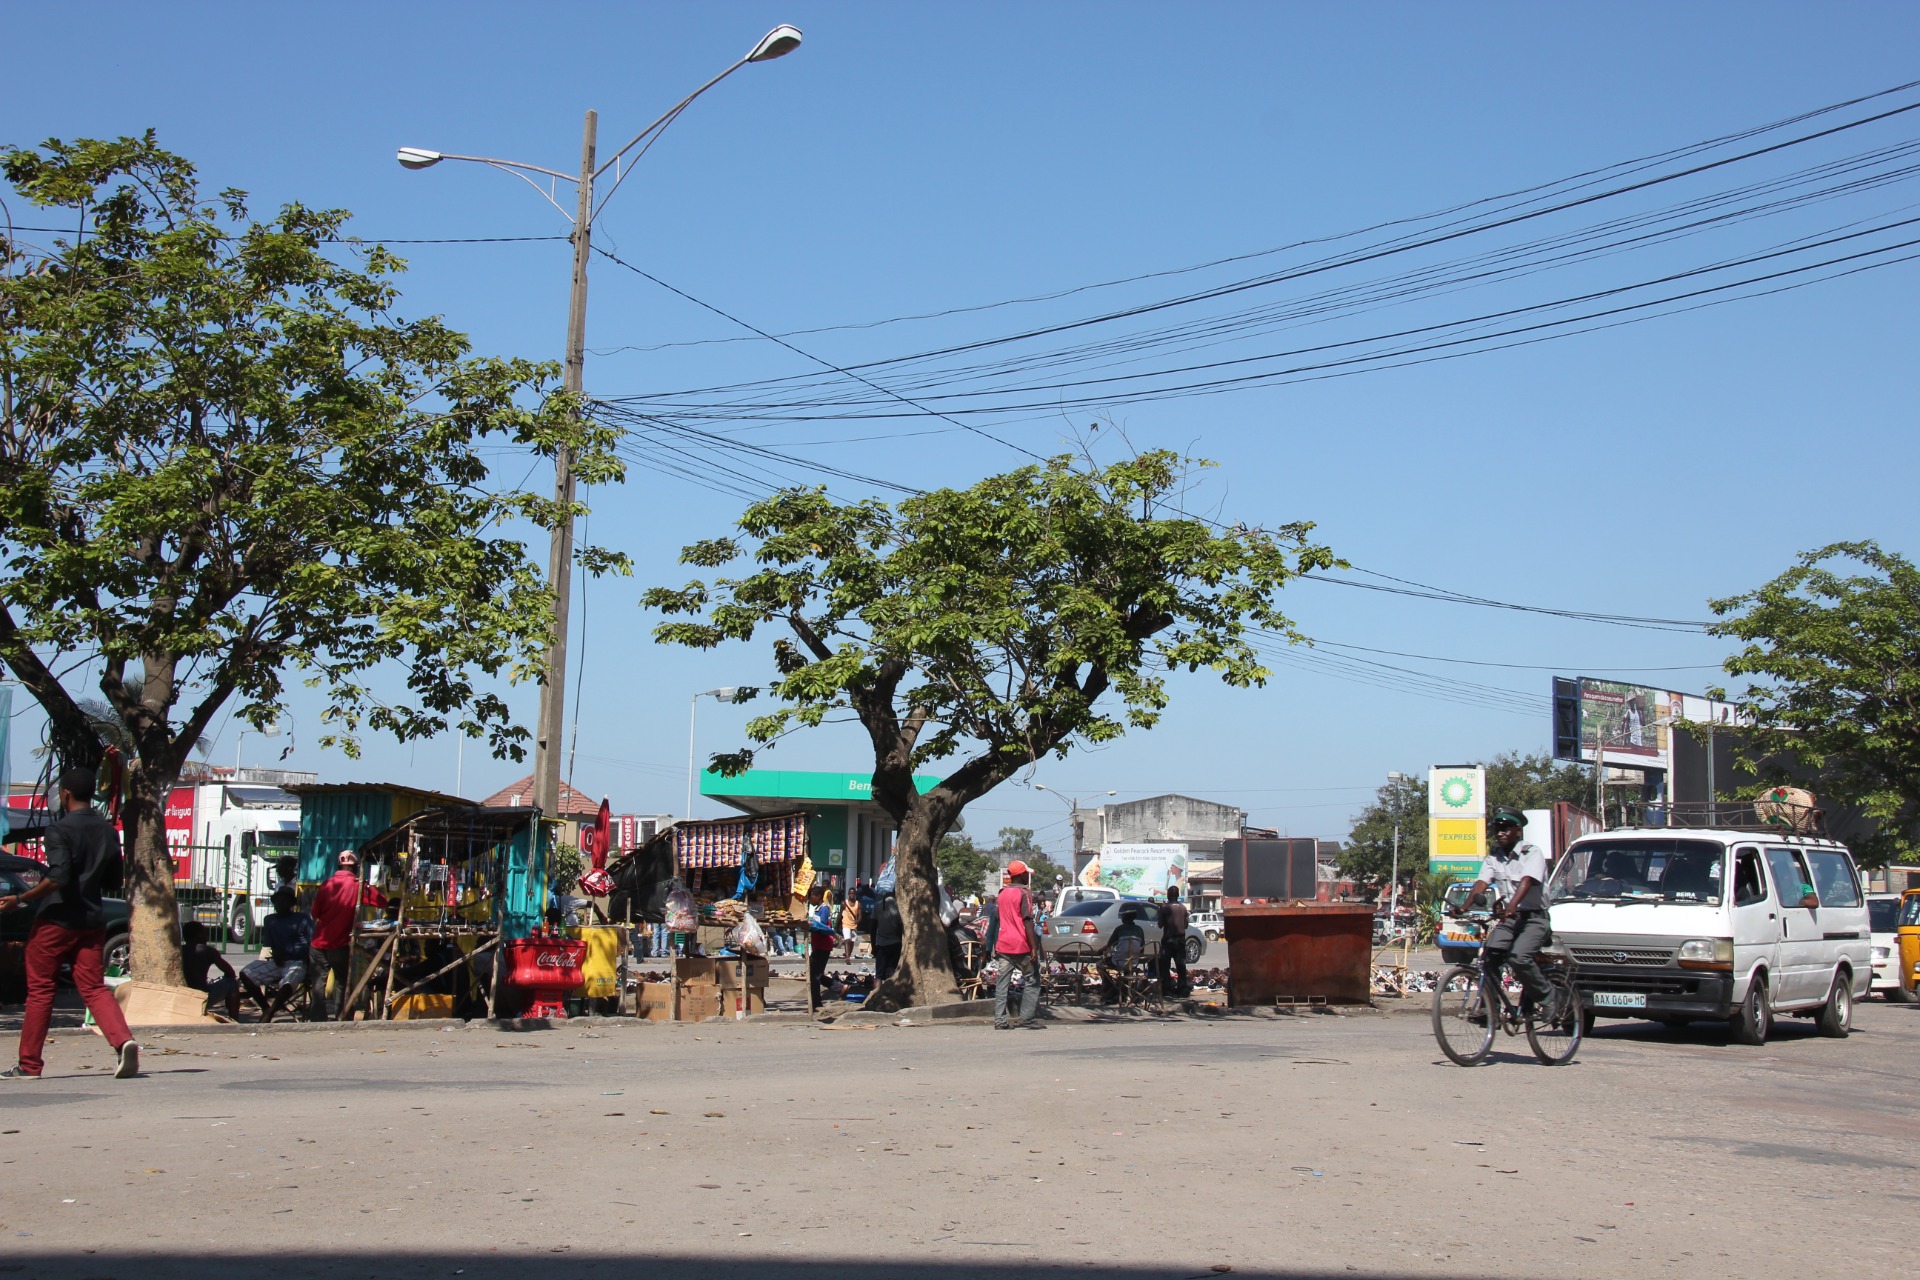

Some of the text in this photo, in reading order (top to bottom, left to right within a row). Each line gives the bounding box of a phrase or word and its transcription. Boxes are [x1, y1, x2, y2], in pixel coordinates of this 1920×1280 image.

[1466, 771, 1476, 779] bp
[1443, 833, 1477, 841] EXPRESS
[537, 949, 580, 968] Coca-Cola
[1595, 994, 1645, 1006] AAX 060 MC
